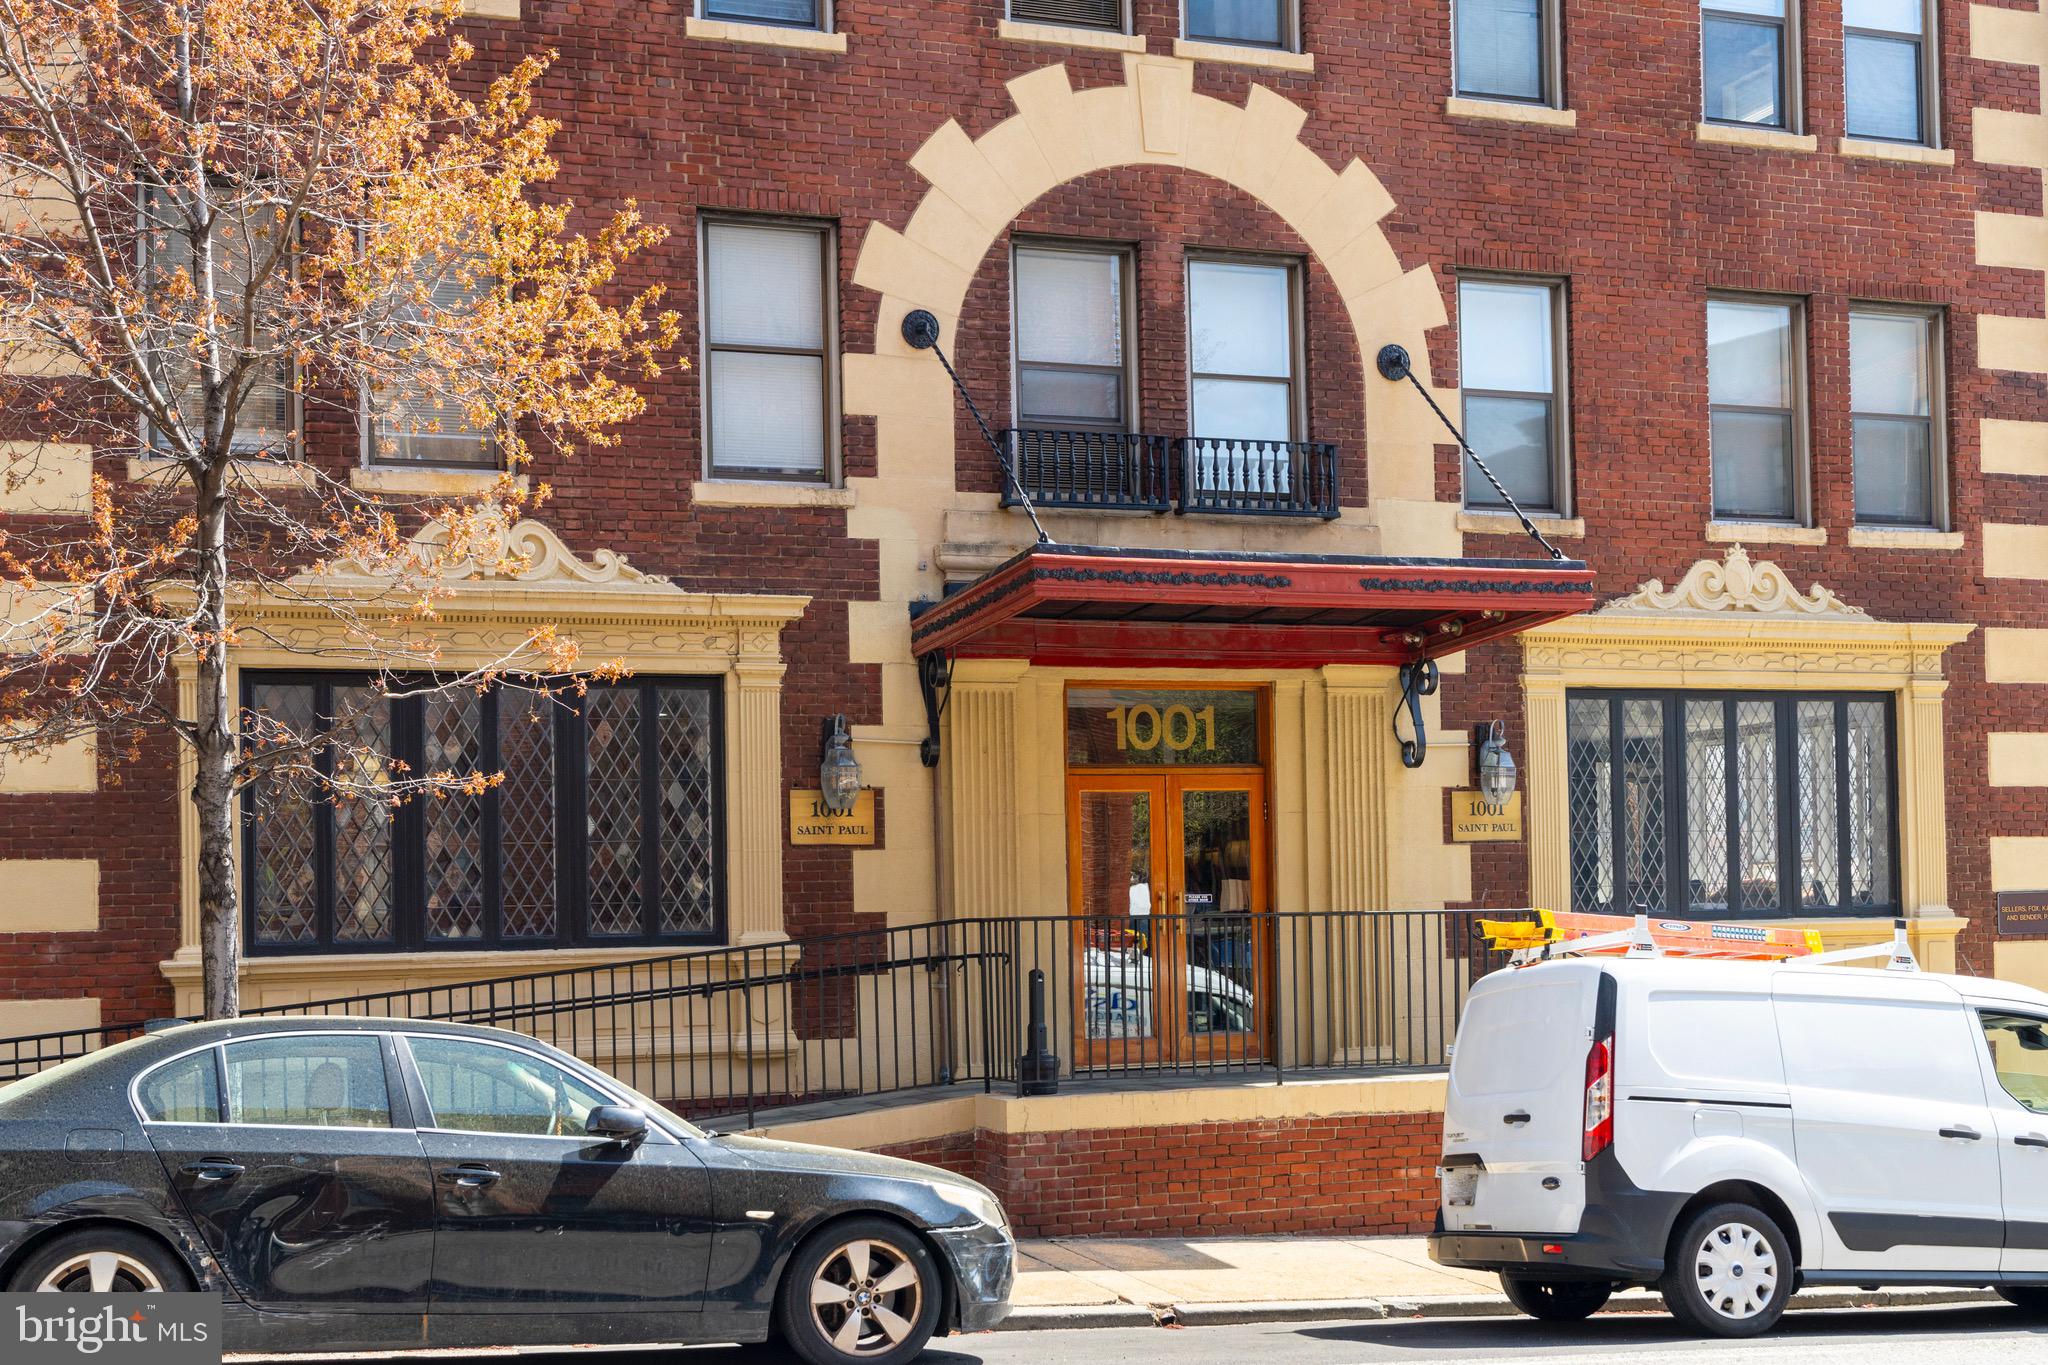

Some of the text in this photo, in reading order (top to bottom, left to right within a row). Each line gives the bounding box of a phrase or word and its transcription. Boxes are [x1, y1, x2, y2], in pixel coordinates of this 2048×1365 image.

[1106, 703, 1216, 751] 1001
[1469, 800, 1505, 817] 1001
[797, 825, 868, 835] SAINT PAUL
[1458, 823, 1517, 833] SAINT PAUL
